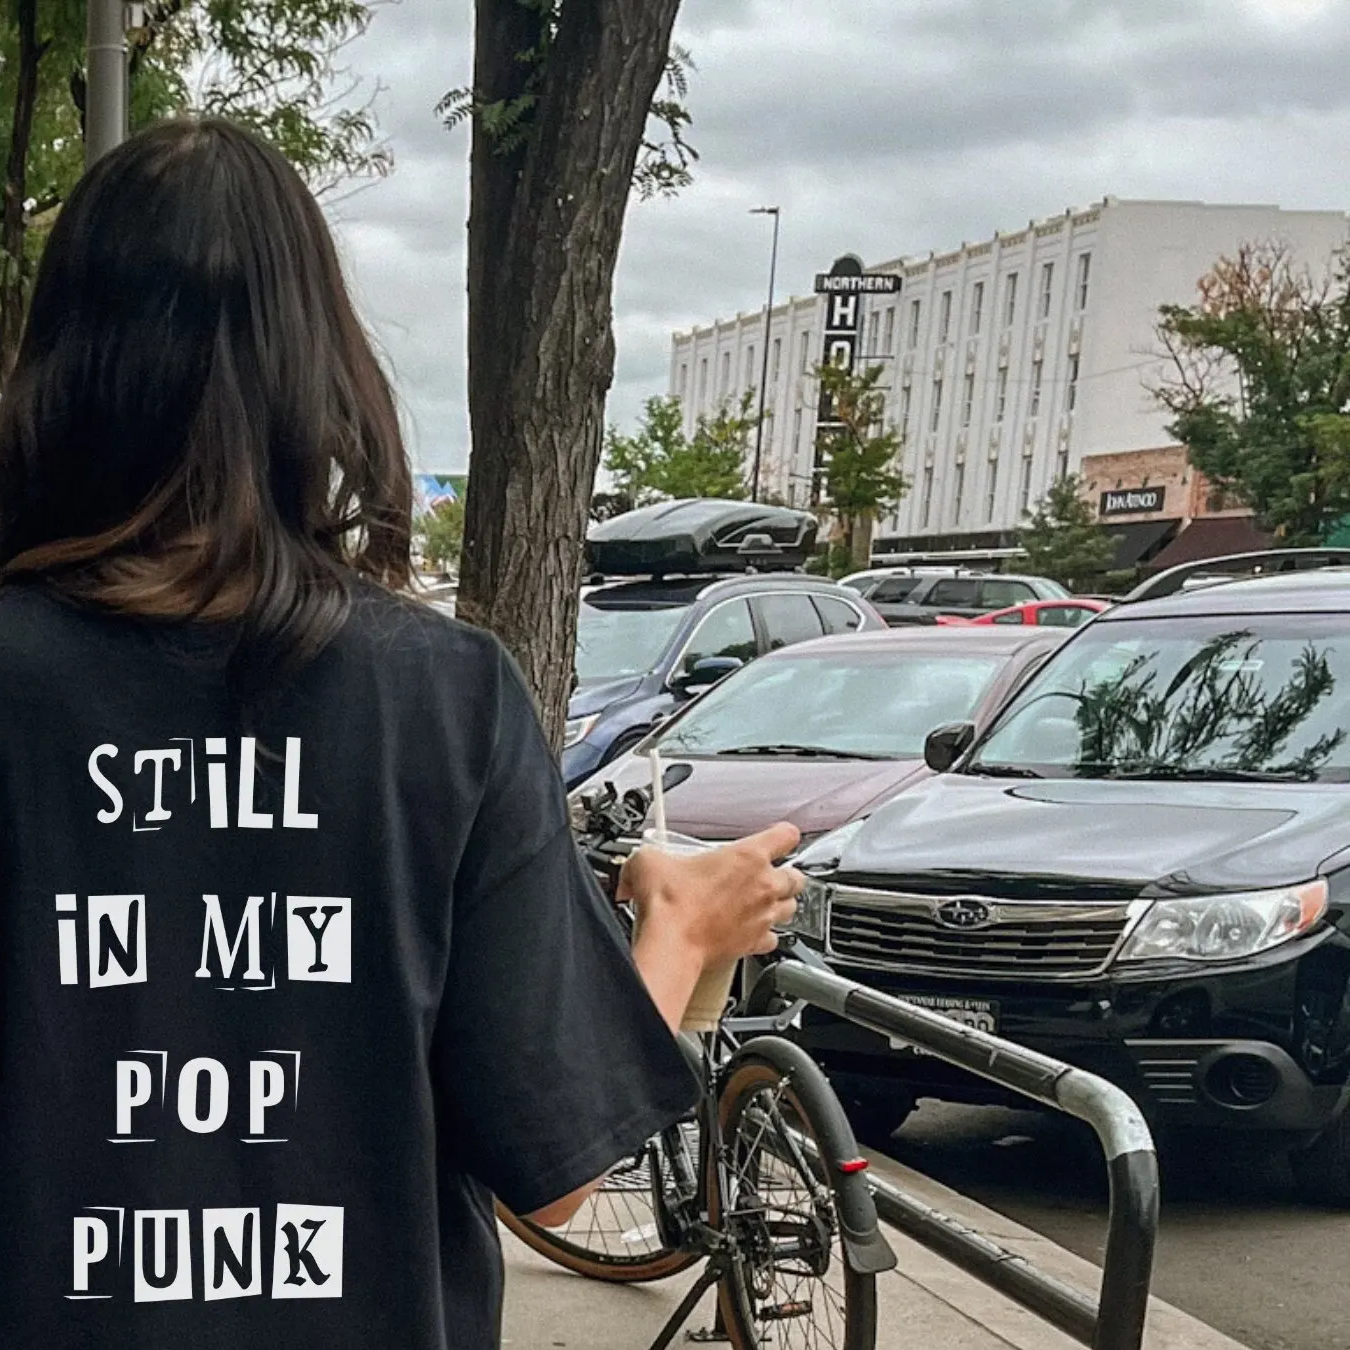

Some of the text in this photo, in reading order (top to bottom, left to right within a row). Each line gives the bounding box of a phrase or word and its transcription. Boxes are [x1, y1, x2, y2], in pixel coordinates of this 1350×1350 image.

[823, 276, 895, 292] NORTHERN
[196, 892, 351, 990] MY
[109, 1050, 300, 1143] POP
[65, 1203, 344, 1302] PUNK
